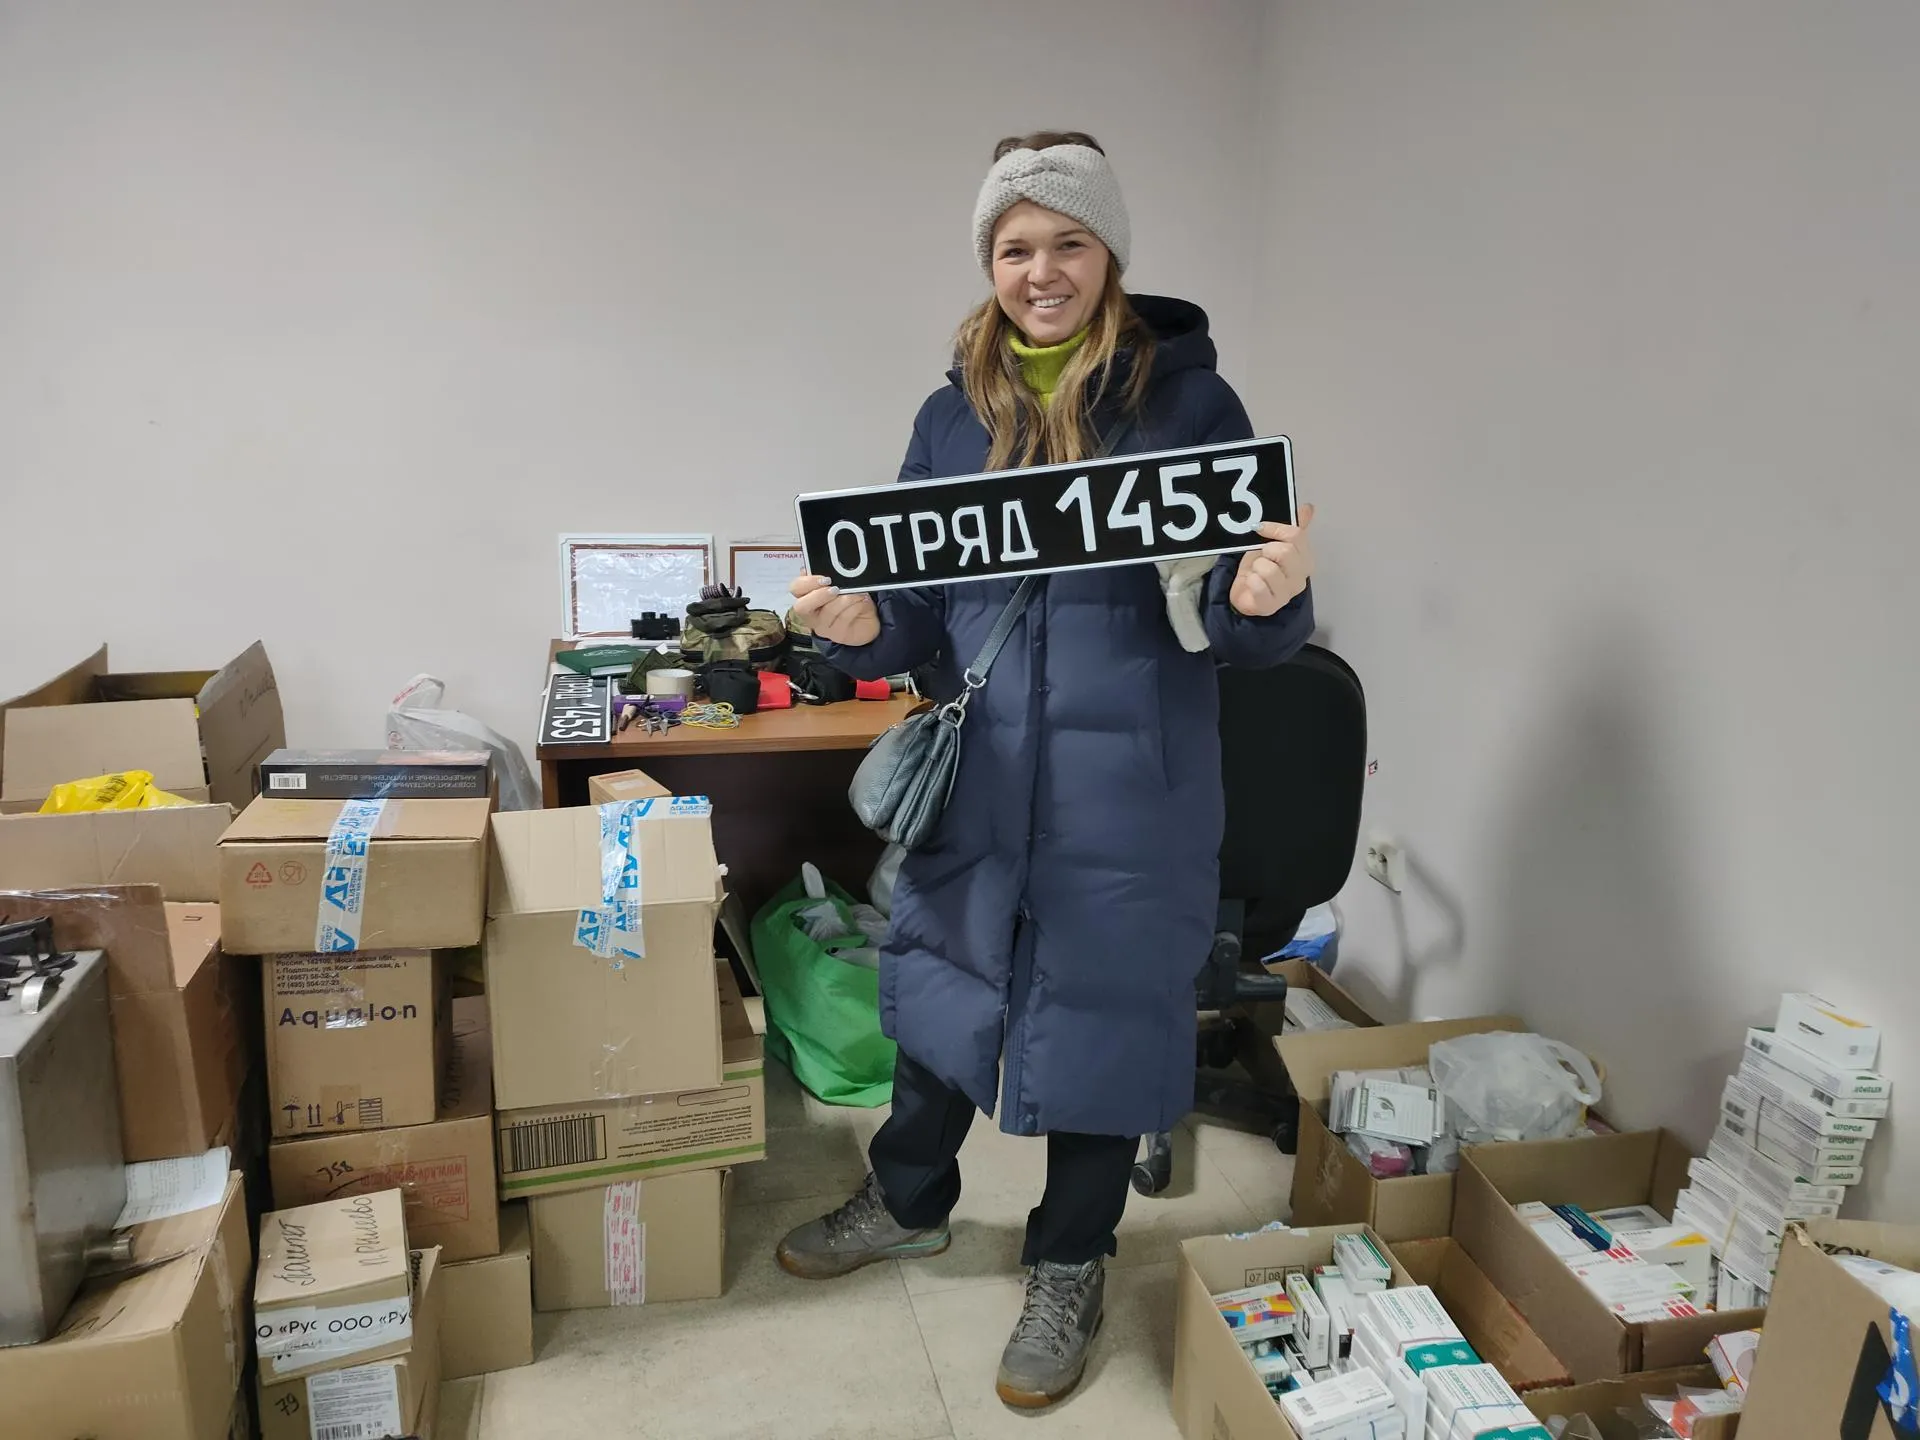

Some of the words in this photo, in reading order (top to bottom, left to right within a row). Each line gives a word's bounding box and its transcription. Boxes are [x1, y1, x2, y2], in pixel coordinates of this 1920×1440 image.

[827, 499, 1039, 578] ОТРЯД
[1055, 455, 1264, 553] 1453
[549, 703, 602, 739] 1453
[1249, 1273, 1262, 1282] 07
[1268, 1271, 1281, 1281] 08
[328, 1315, 373, 1333] ООО
[275, 1392, 300, 1416] 79
